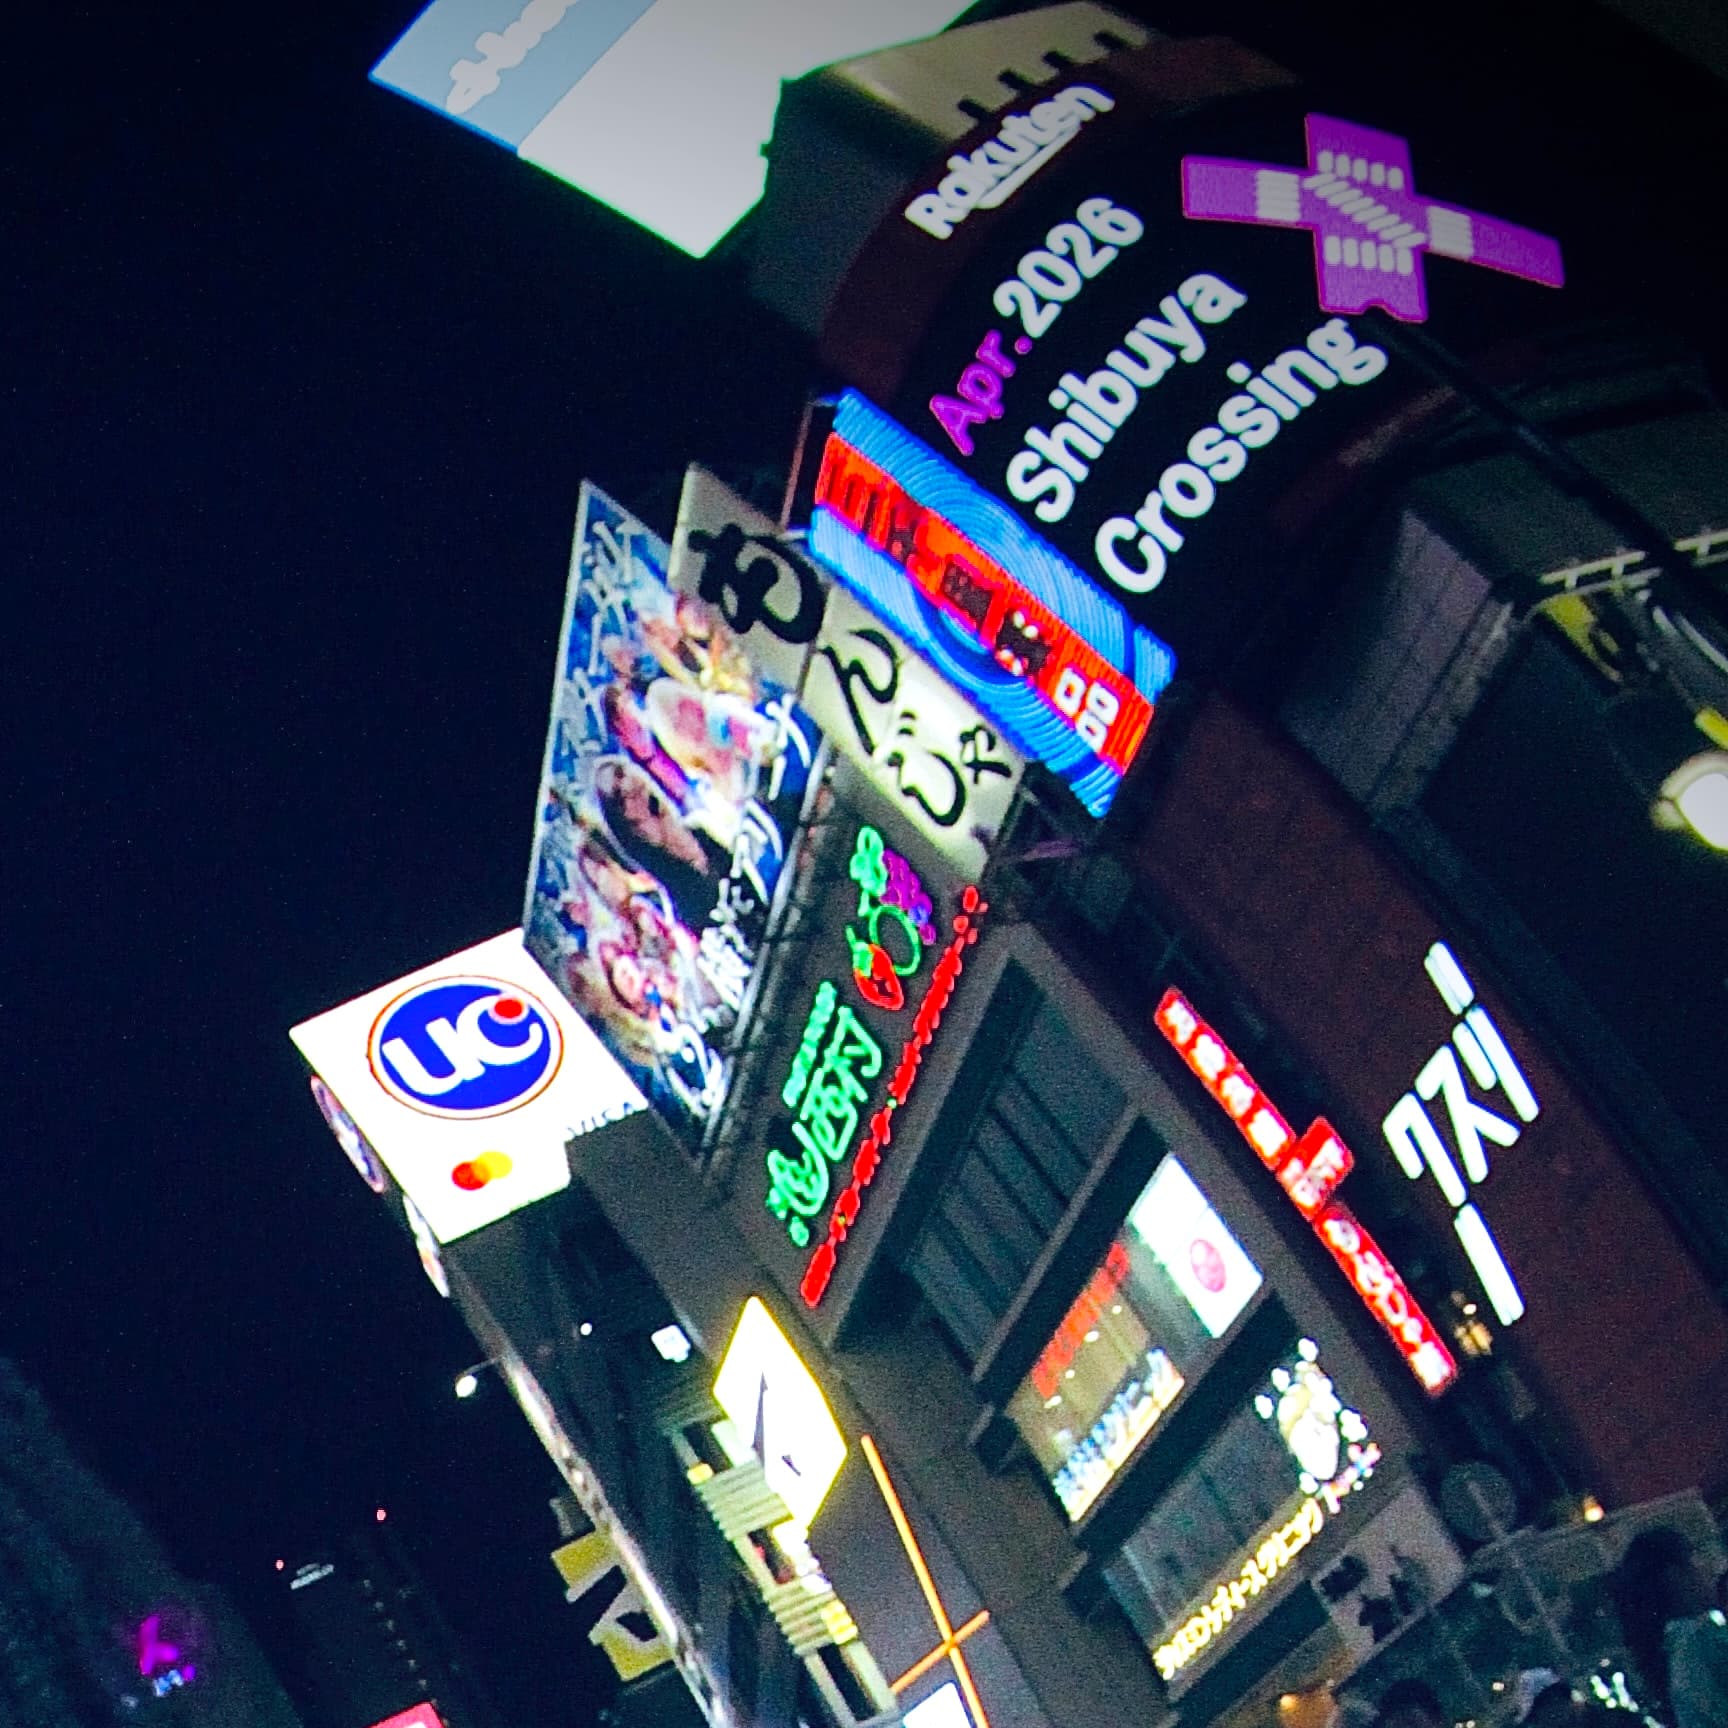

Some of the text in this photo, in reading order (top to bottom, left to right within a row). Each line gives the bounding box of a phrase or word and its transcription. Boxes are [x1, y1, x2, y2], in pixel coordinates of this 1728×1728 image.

[904, 85, 1115, 240] Rakuten
[1005, 272, 1248, 524] Shibuya
[1094, 317, 1389, 594] Crossing
[381, 994, 544, 1097] UC
